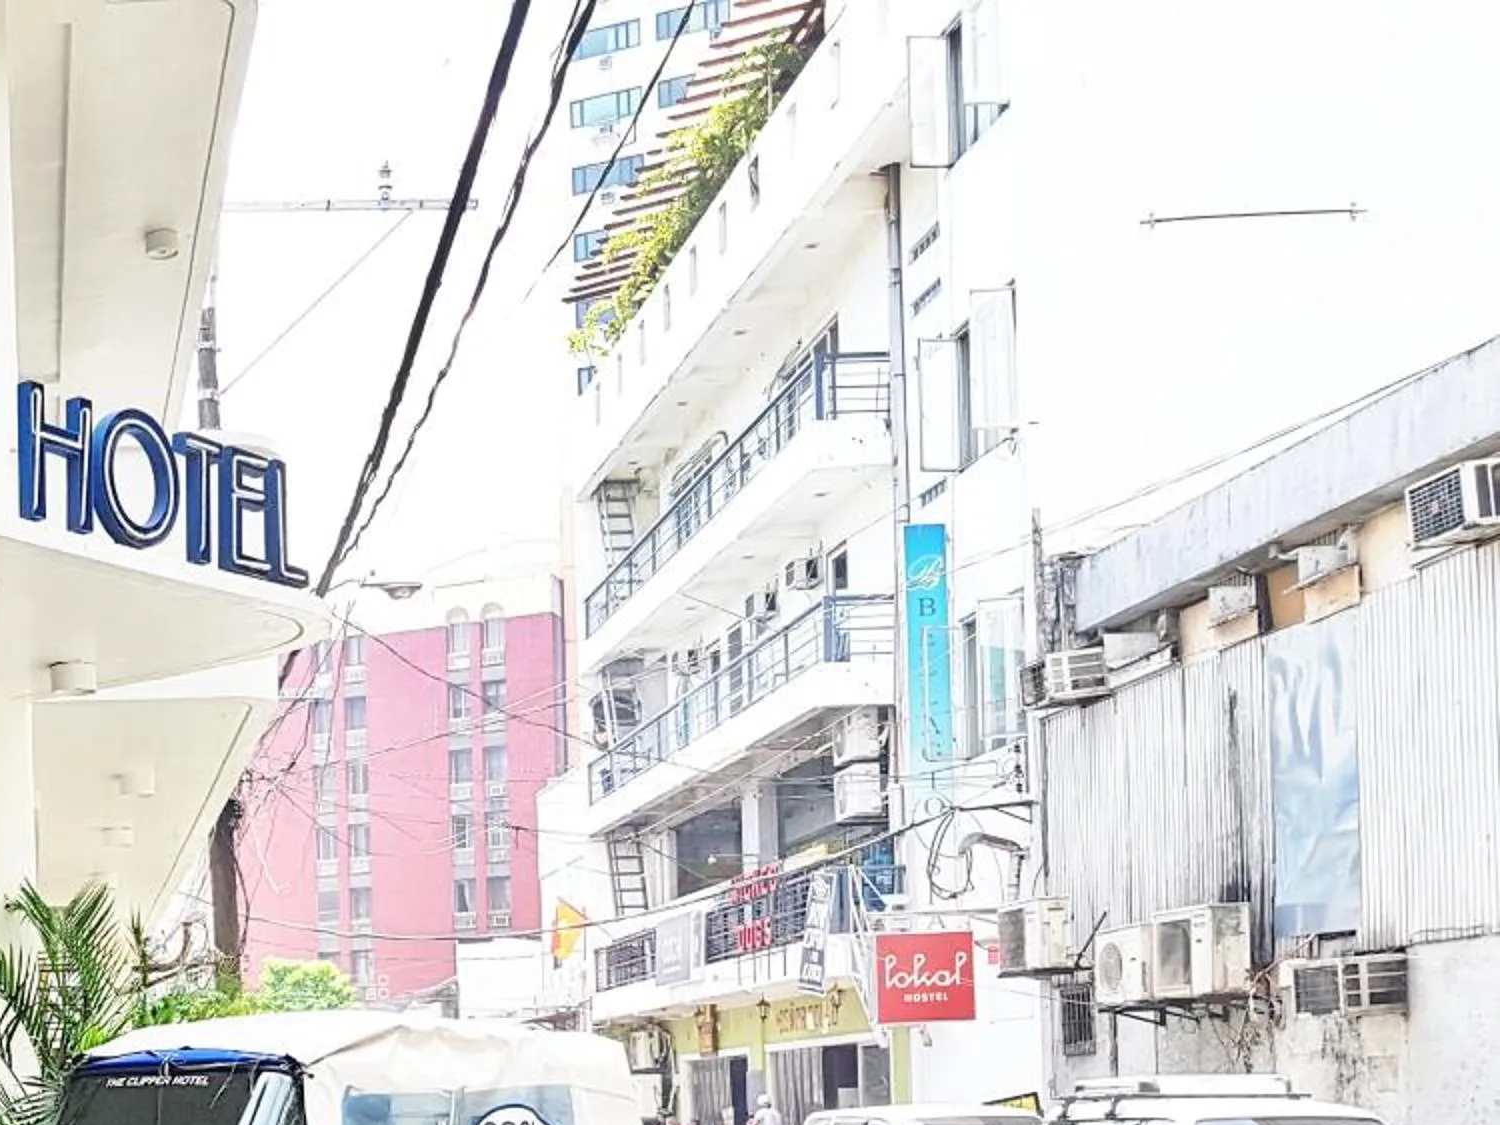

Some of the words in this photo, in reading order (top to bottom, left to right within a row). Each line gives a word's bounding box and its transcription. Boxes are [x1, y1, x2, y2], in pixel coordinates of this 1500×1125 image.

[17, 380, 309, 589] HOTEL
[884, 951, 968, 989] lokal
[902, 991, 949, 1003] HOSTEL
[172, 1075, 209, 1087] HOTEL
